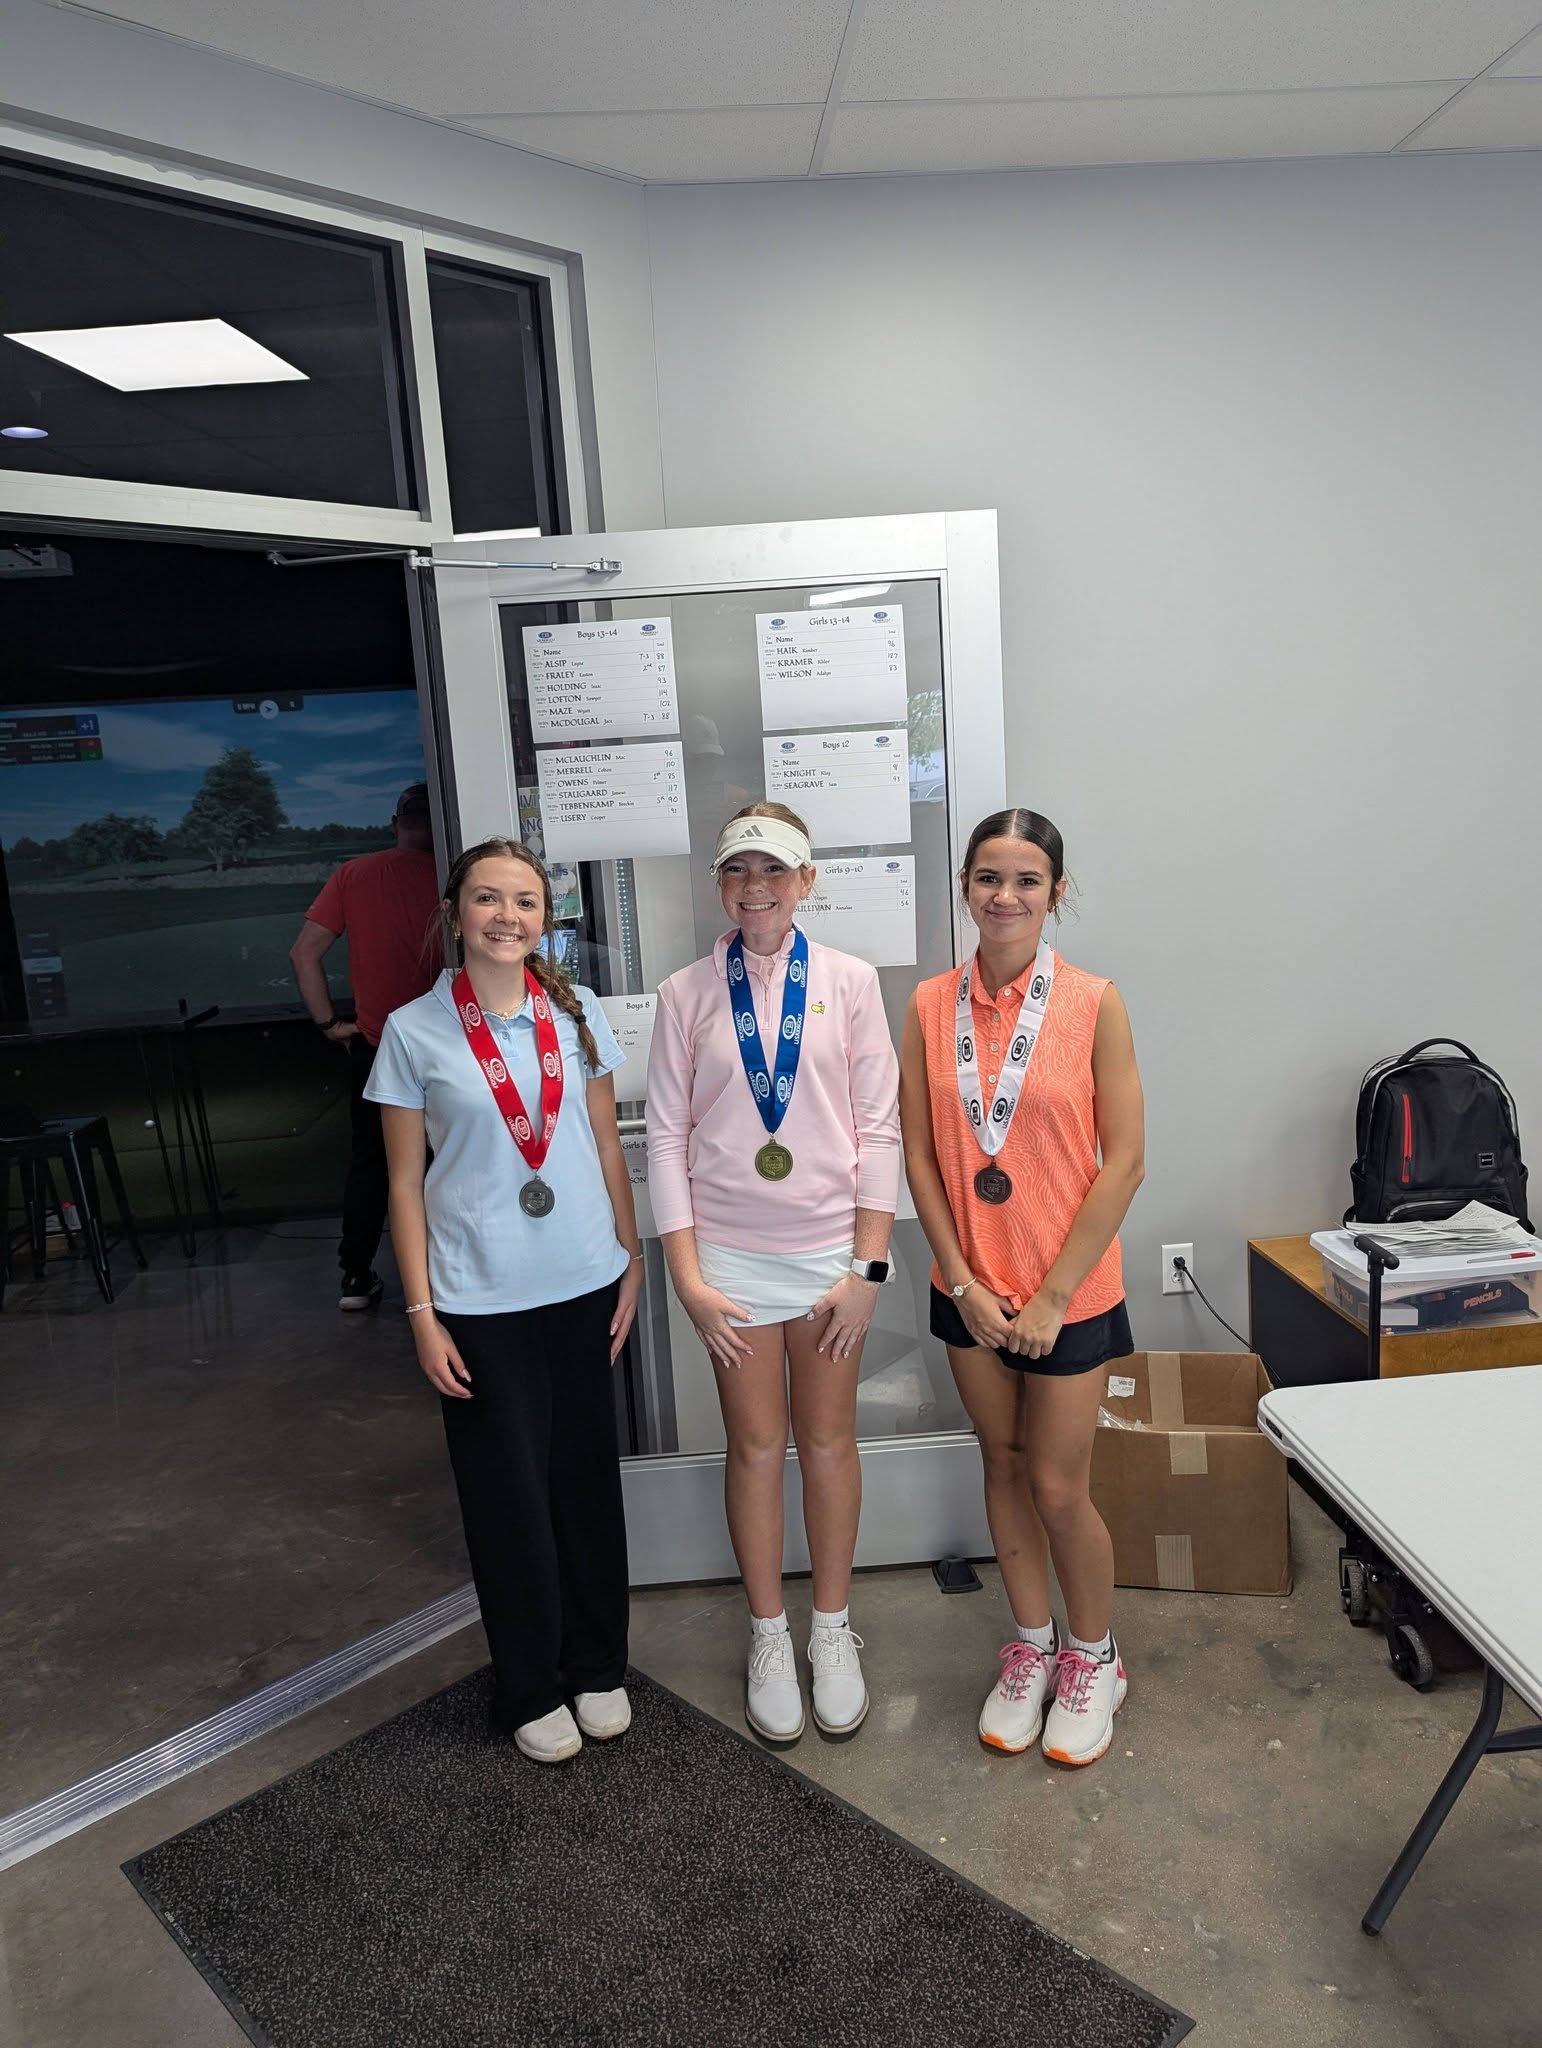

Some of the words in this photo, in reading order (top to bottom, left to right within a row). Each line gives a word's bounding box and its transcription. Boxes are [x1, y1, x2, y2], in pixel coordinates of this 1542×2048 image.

[809, 617, 828, 626] Girls
[830, 616, 850, 625] 13-14
[577, 630, 595, 640] Boys
[597, 629, 618, 638] 13-14
[776, 646, 798, 655] HAIK
[545, 660, 567, 668] ALSIP
[778, 658, 813, 667] KRAMER
[546, 670, 575, 680] FRALEY
[778, 670, 812, 678] WILSON
[547, 682, 587, 692] HOLDING
[548, 695, 581, 704] LOFTON
[549, 707, 573, 715] MAZE
[81, 720, 94, 730] +1
[550, 717, 600, 727] MCDOUGAL
[822, 741, 840, 750] Boys
[556, 766, 593, 775] MERRELL
[783, 769, 817, 778] KNIGHT
[557, 779, 588, 787] OWENS
[784, 780, 824, 789] SEAGRAVE
[559, 790, 608, 799] STAUGAARD
[560, 800, 614, 811] TEBBENKAMP
[561, 814, 587, 822] USERY
[825, 865, 844, 874] Girls
[845, 865, 863, 874] 9-10
[626, 1002, 643, 1011] Boys
[622, 1141, 640, 1150] Girls
[1464, 1288, 1502, 1309] PENCILS
